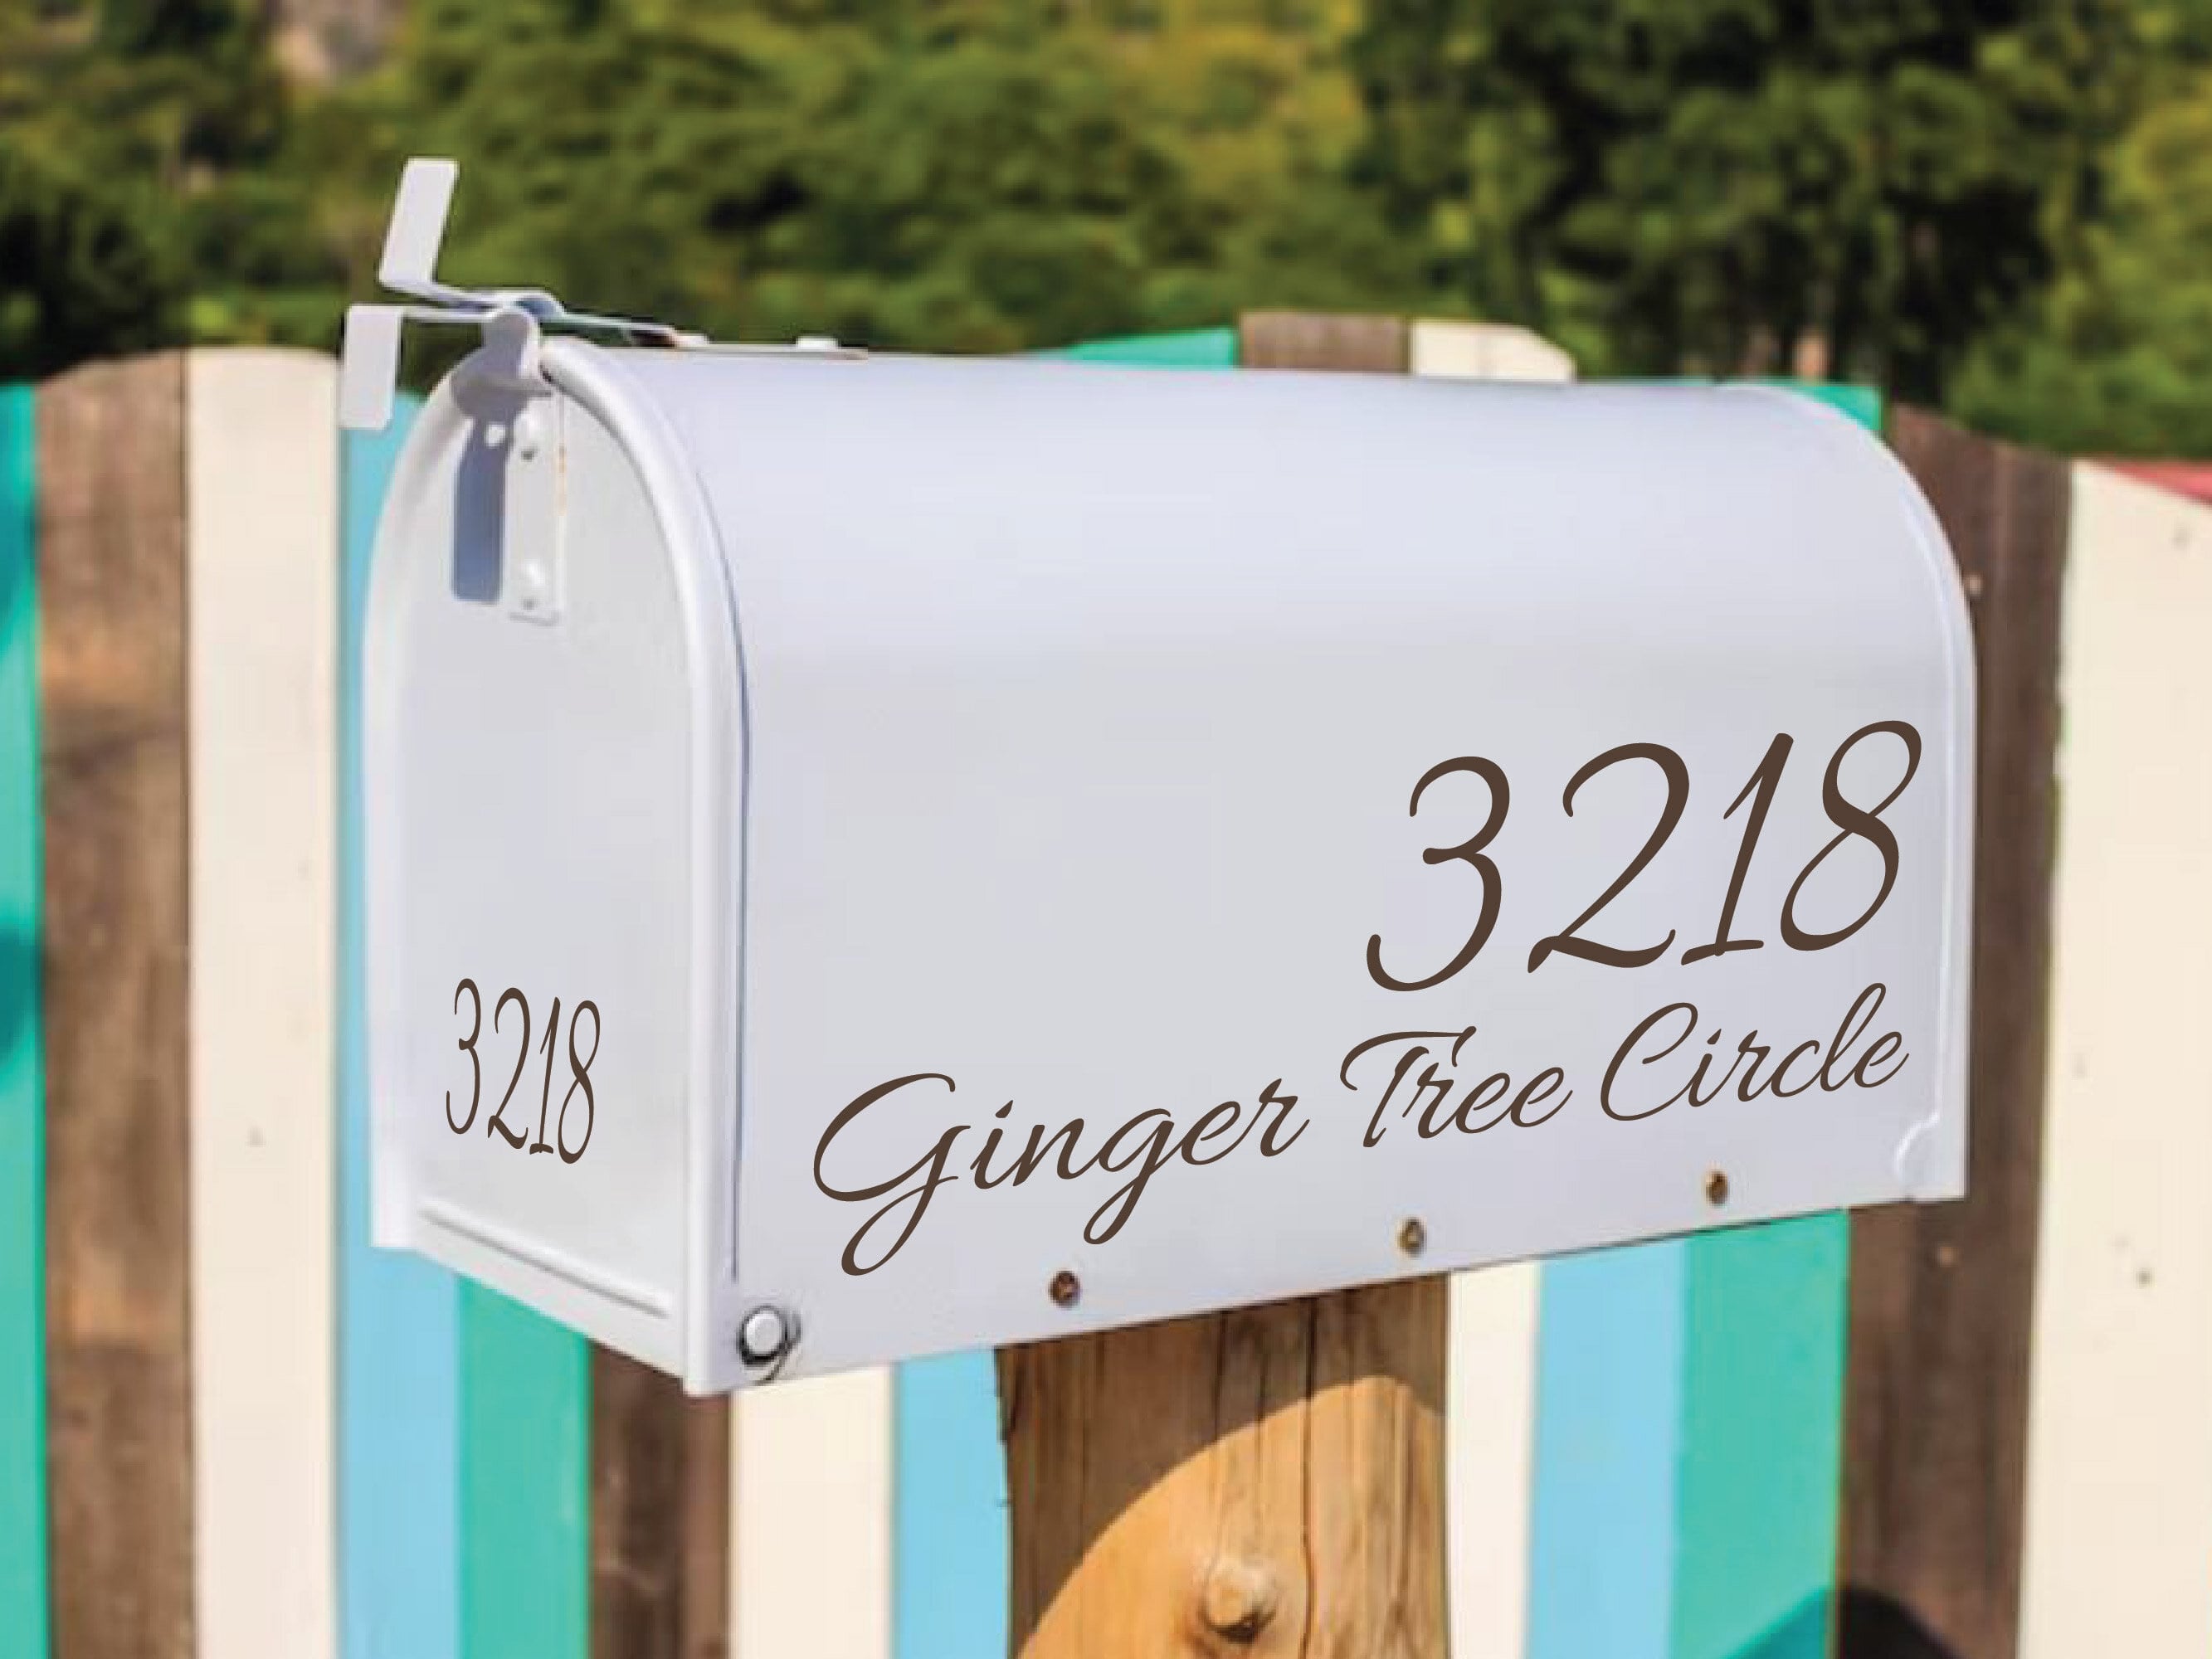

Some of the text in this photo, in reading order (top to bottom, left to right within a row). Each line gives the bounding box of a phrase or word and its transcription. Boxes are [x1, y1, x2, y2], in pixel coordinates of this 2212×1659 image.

[1366, 720, 1922, 992] 3218
[446, 978, 601, 1165] 3218
[813, 982, 1910, 1277] Ginger Tree Circle
